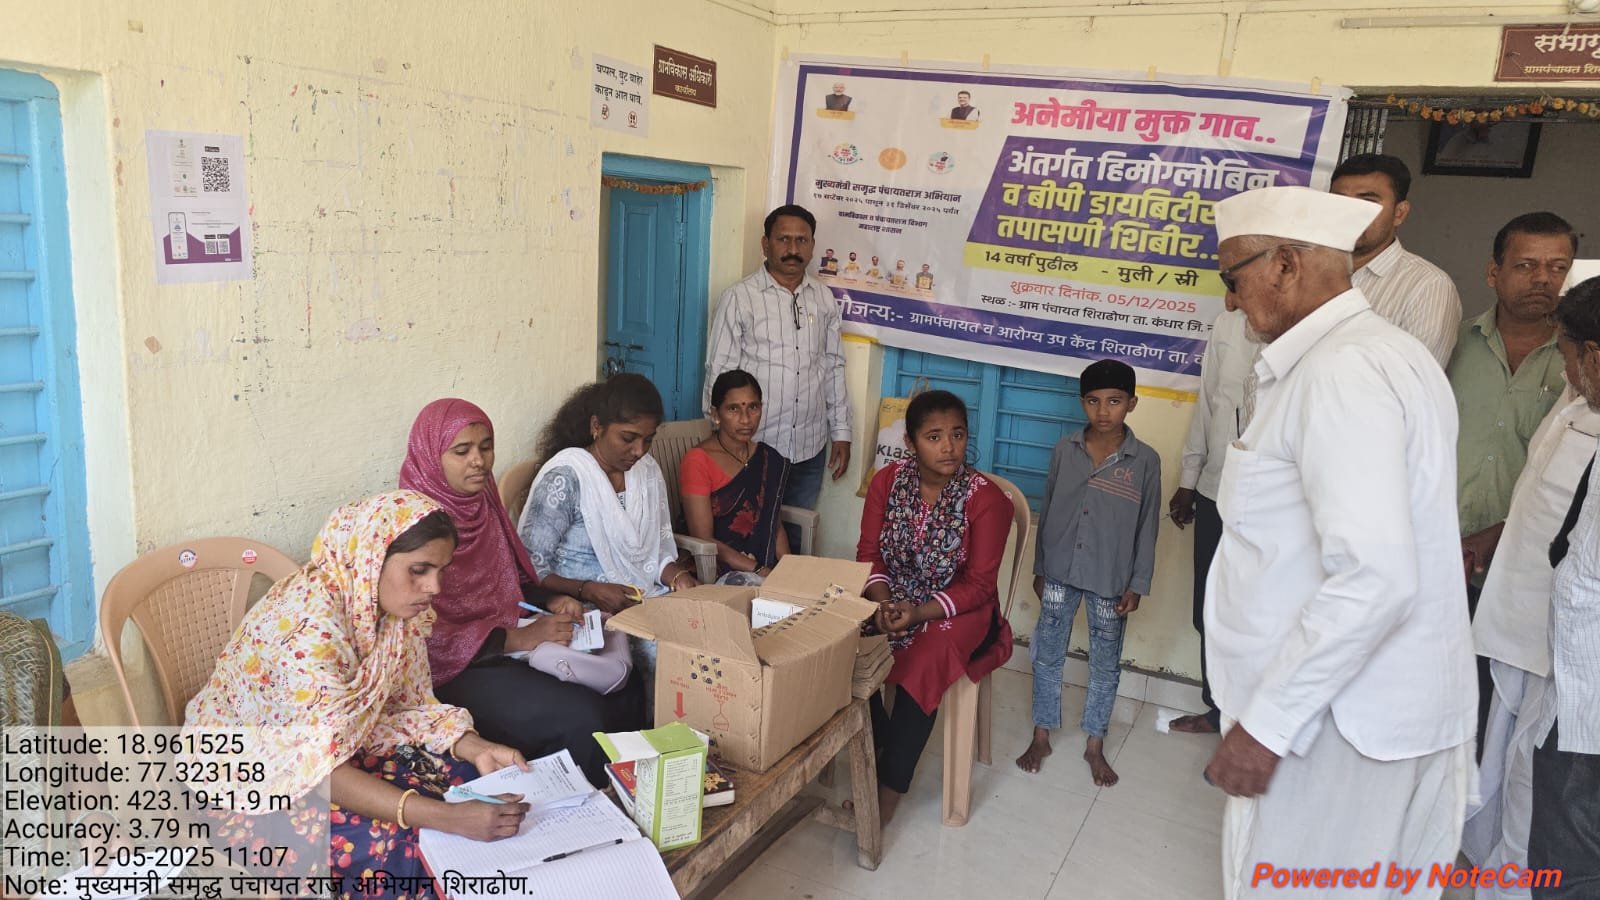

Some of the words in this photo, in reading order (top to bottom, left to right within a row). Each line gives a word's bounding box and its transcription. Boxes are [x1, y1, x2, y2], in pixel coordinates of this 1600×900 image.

[688, 65, 712, 86] अधिकारी
[1011, 97, 1131, 132] अनेमीया
[1135, 109, 1196, 142] मुक्त
[1199, 112, 1276, 144] गाव..
[1008, 145, 1093, 180] अंतर्गत
[1097, 150, 1280, 191] हिमोग्लोबिन
[815, 180, 851, 190] मुख्यमंत्री
[853, 184, 877, 195] समृद्ध
[878, 185, 922, 198] पंचायतराज
[923, 190, 962, 202] अभियान
[1002, 182, 1024, 206] व
[1027, 181, 1086, 212] बीपी
[997, 214, 1106, 248] तपासणी
[985, 250, 1000, 263] 14
[1004, 251, 1033, 267] वर्षा
[1036, 255, 1078, 273] पुढील
[1118, 265, 1154, 284] मुली
[1010, 280, 1054, 296] शुक्रवार
[1058, 283, 1102, 302] दिनांक.
[1107, 293, 1196, 313] 05/12/2025
[1019, 300, 1040, 311] ग्राम
[1041, 302, 1079, 317] पंचायत
[1082, 307, 1129, 324] शिराढोण
[1133, 315, 1148, 326] ता.
[1151, 315, 1184, 329] कंधार
[1187, 319, 1204, 333] जि.
[909, 312, 982, 334] ग्रामपंचायत
[982, 323, 995, 336] व
[998, 326, 1043, 343] आरोग्य
[1046, 333, 1066, 347] उप
[1070, 334, 1097, 351] केंद्र
[1100, 339, 1163, 360] शिराढोण
[1168, 350, 1189, 365] ता.
